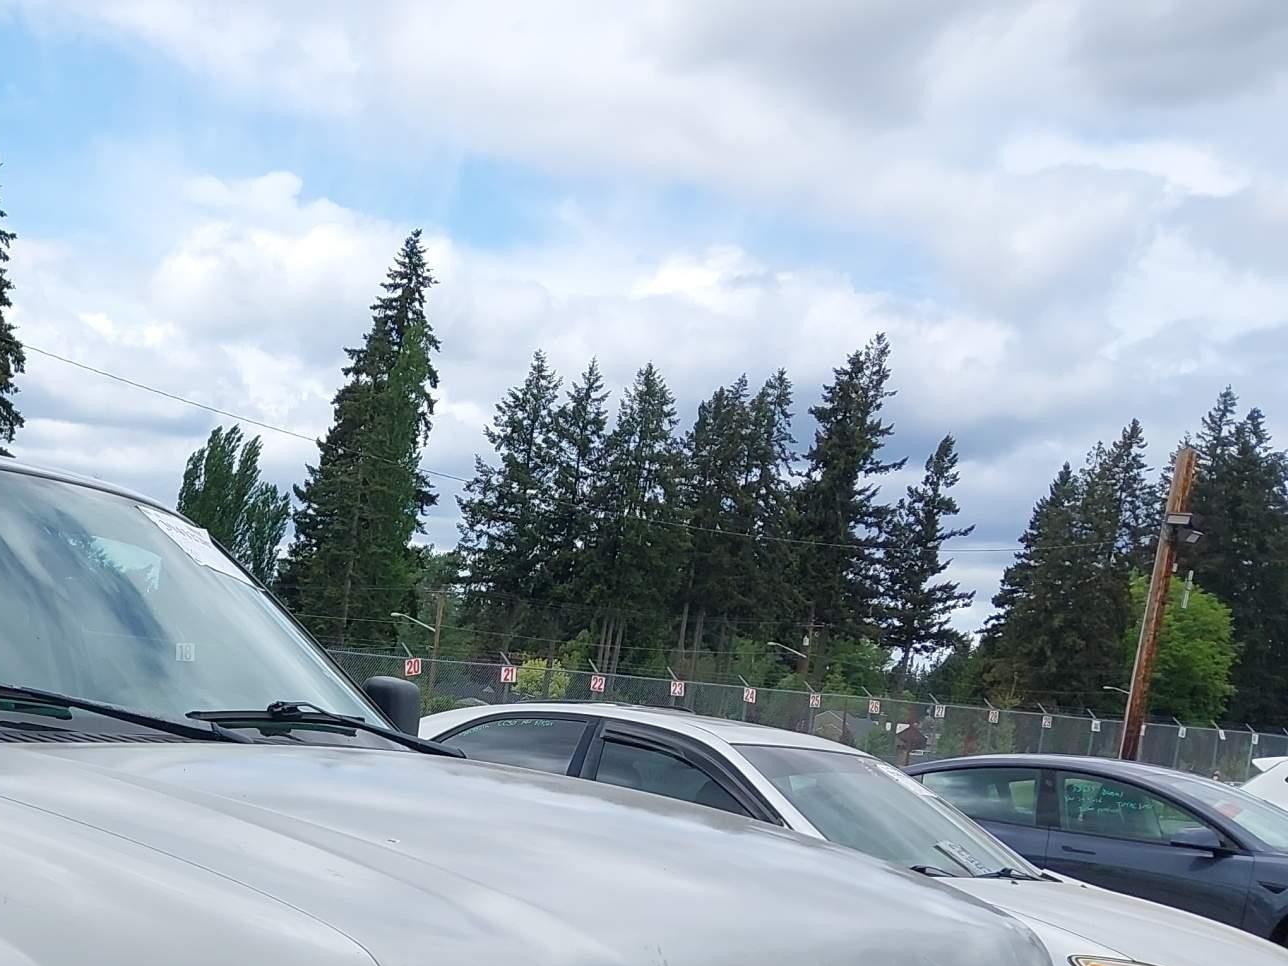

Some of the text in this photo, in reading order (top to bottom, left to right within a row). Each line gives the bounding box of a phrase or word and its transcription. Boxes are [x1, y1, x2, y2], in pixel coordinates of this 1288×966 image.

[407, 660, 420, 675] 20
[503, 668, 515, 682] 21
[592, 676, 604, 691] 22
[672, 683, 683, 696] 23
[745, 689, 756, 702] 24
[810, 695, 820, 707] 25
[869, 701, 880, 713] 26
[935, 706, 945, 717] 27
